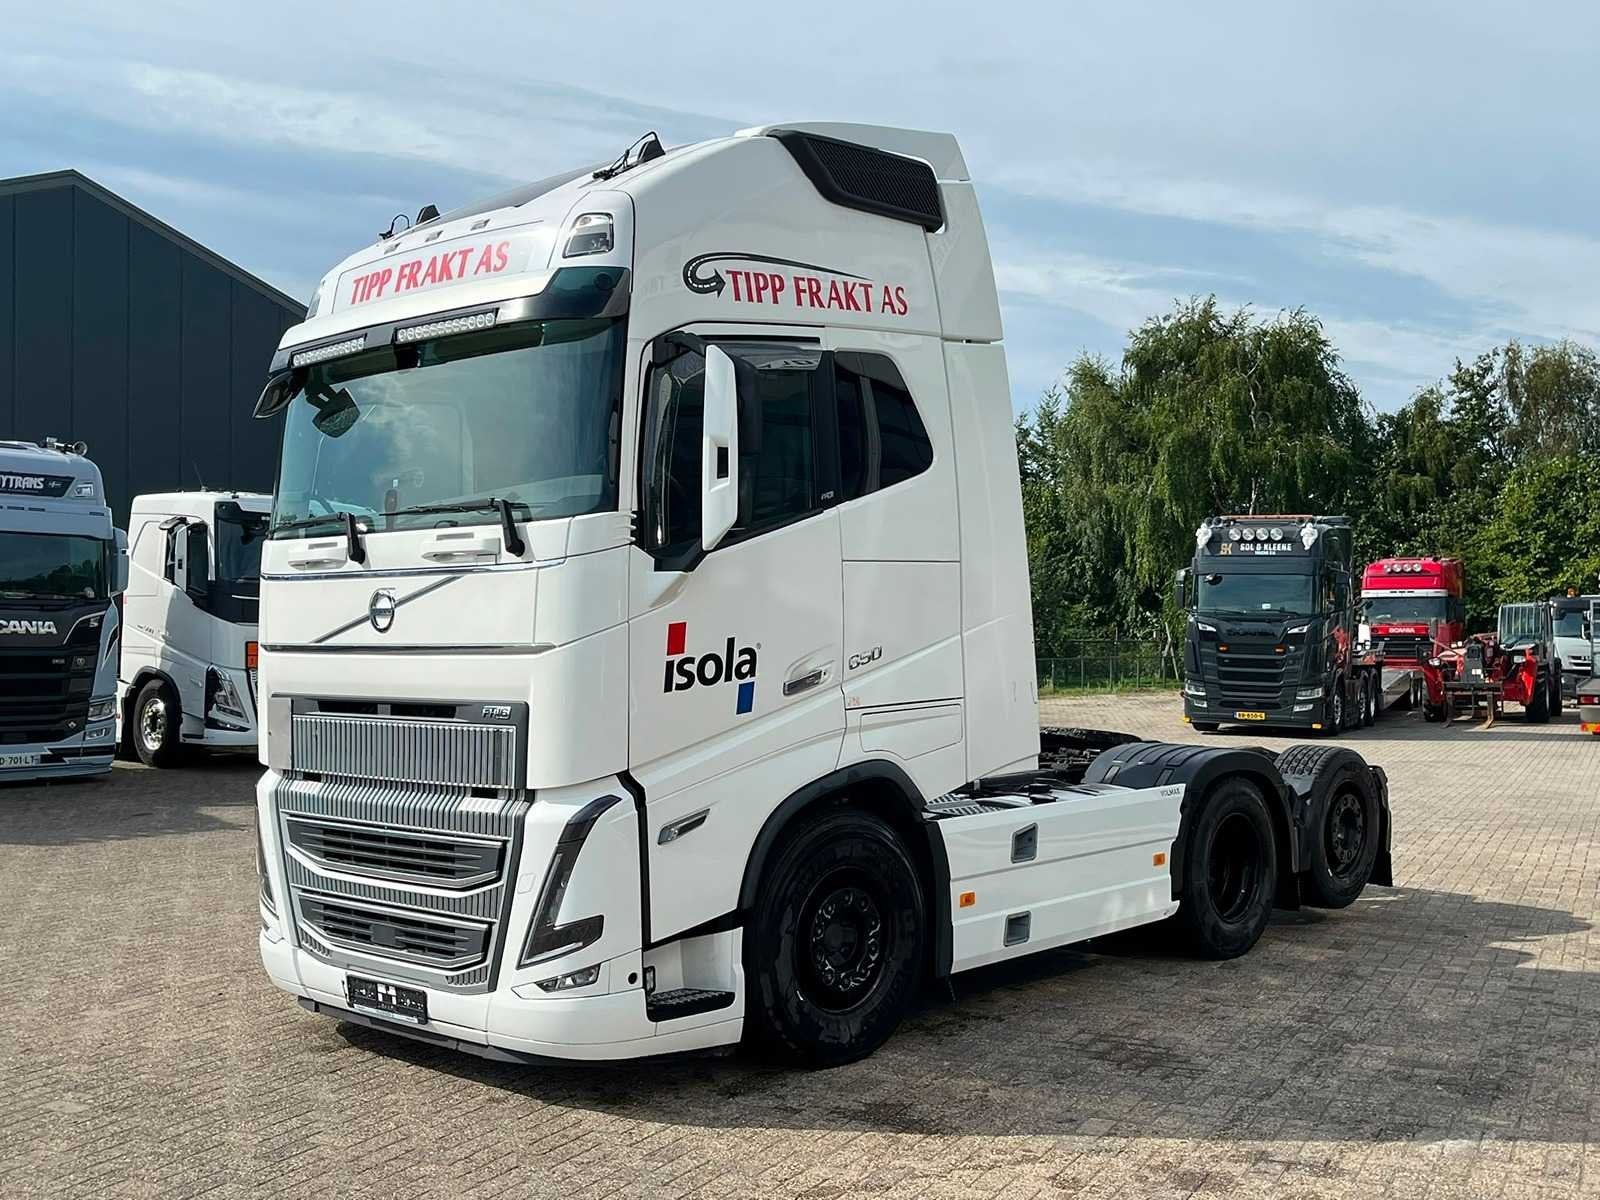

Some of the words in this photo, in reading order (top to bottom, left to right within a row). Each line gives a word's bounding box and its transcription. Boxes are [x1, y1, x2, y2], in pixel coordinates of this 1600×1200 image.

[351, 268, 393, 305] TIPP
[394, 248, 474, 293] FRAKT
[474, 241, 510, 276] AS
[725, 270, 785, 305] TIPP
[793, 276, 873, 313] FRAKT
[881, 285, 908, 316] AS
[663, 623, 758, 693] isola
[849, 646, 882, 671] 650
